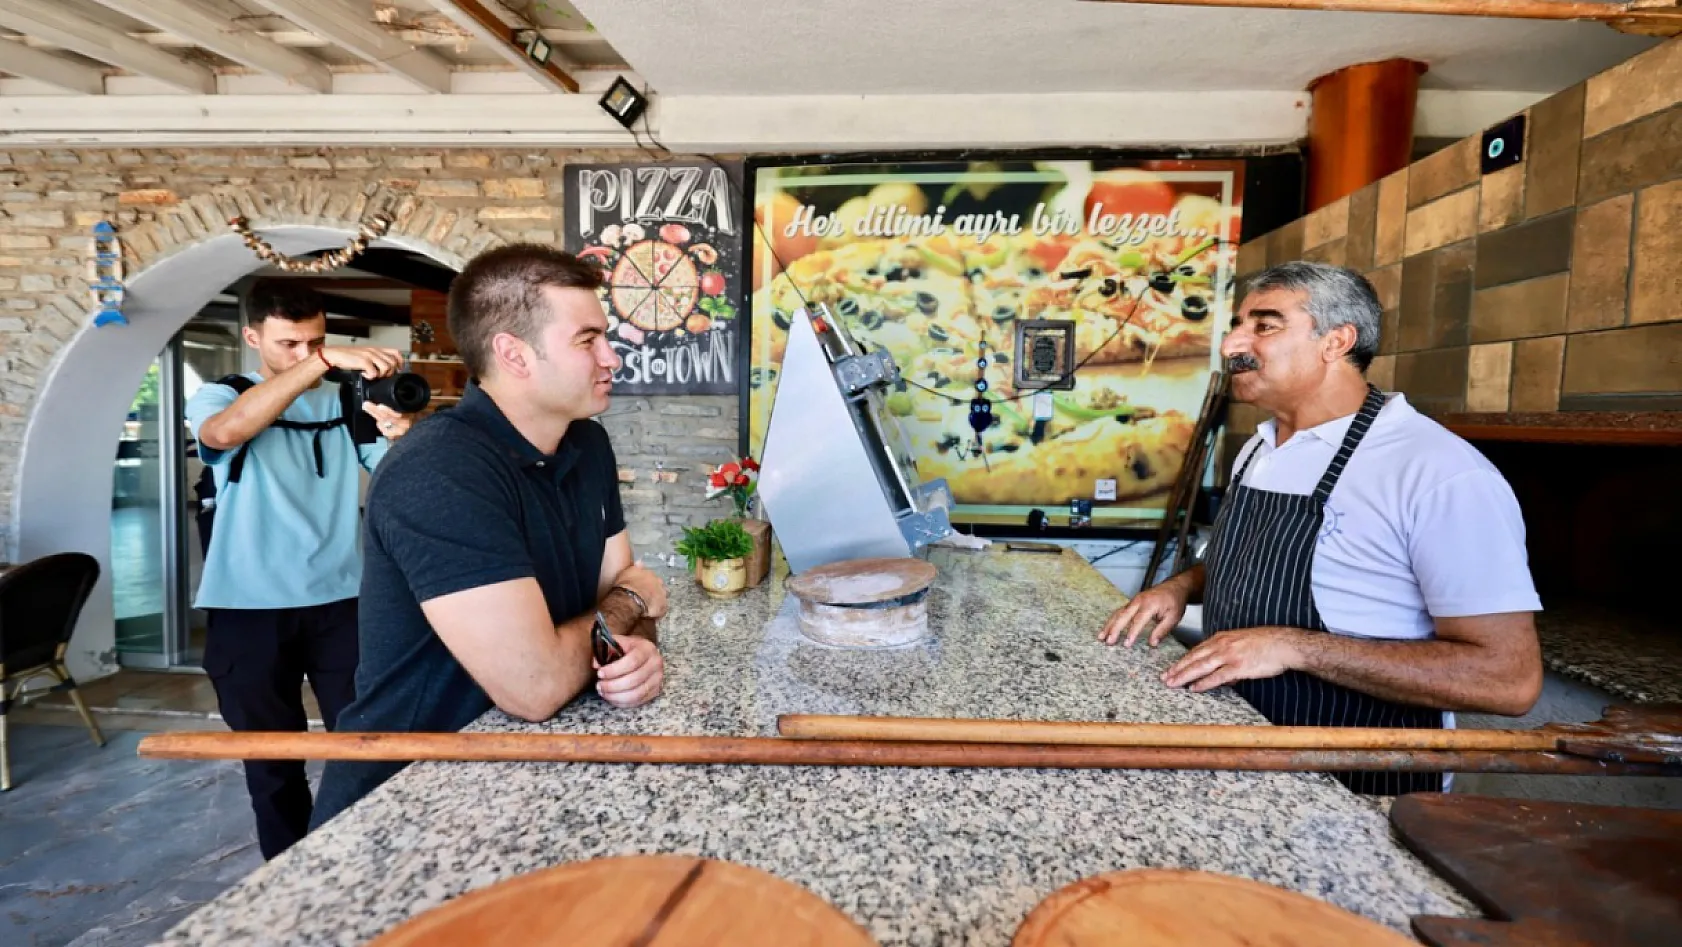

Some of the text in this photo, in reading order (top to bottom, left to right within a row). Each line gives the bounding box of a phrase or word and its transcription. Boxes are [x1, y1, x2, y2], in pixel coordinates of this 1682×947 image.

[579, 166, 734, 238] PIZZA
[783, 202, 1208, 246] Her dilimi ayrı bir lezzet...
[609, 340, 656, 384] est
[662, 329, 733, 384] TOWN
